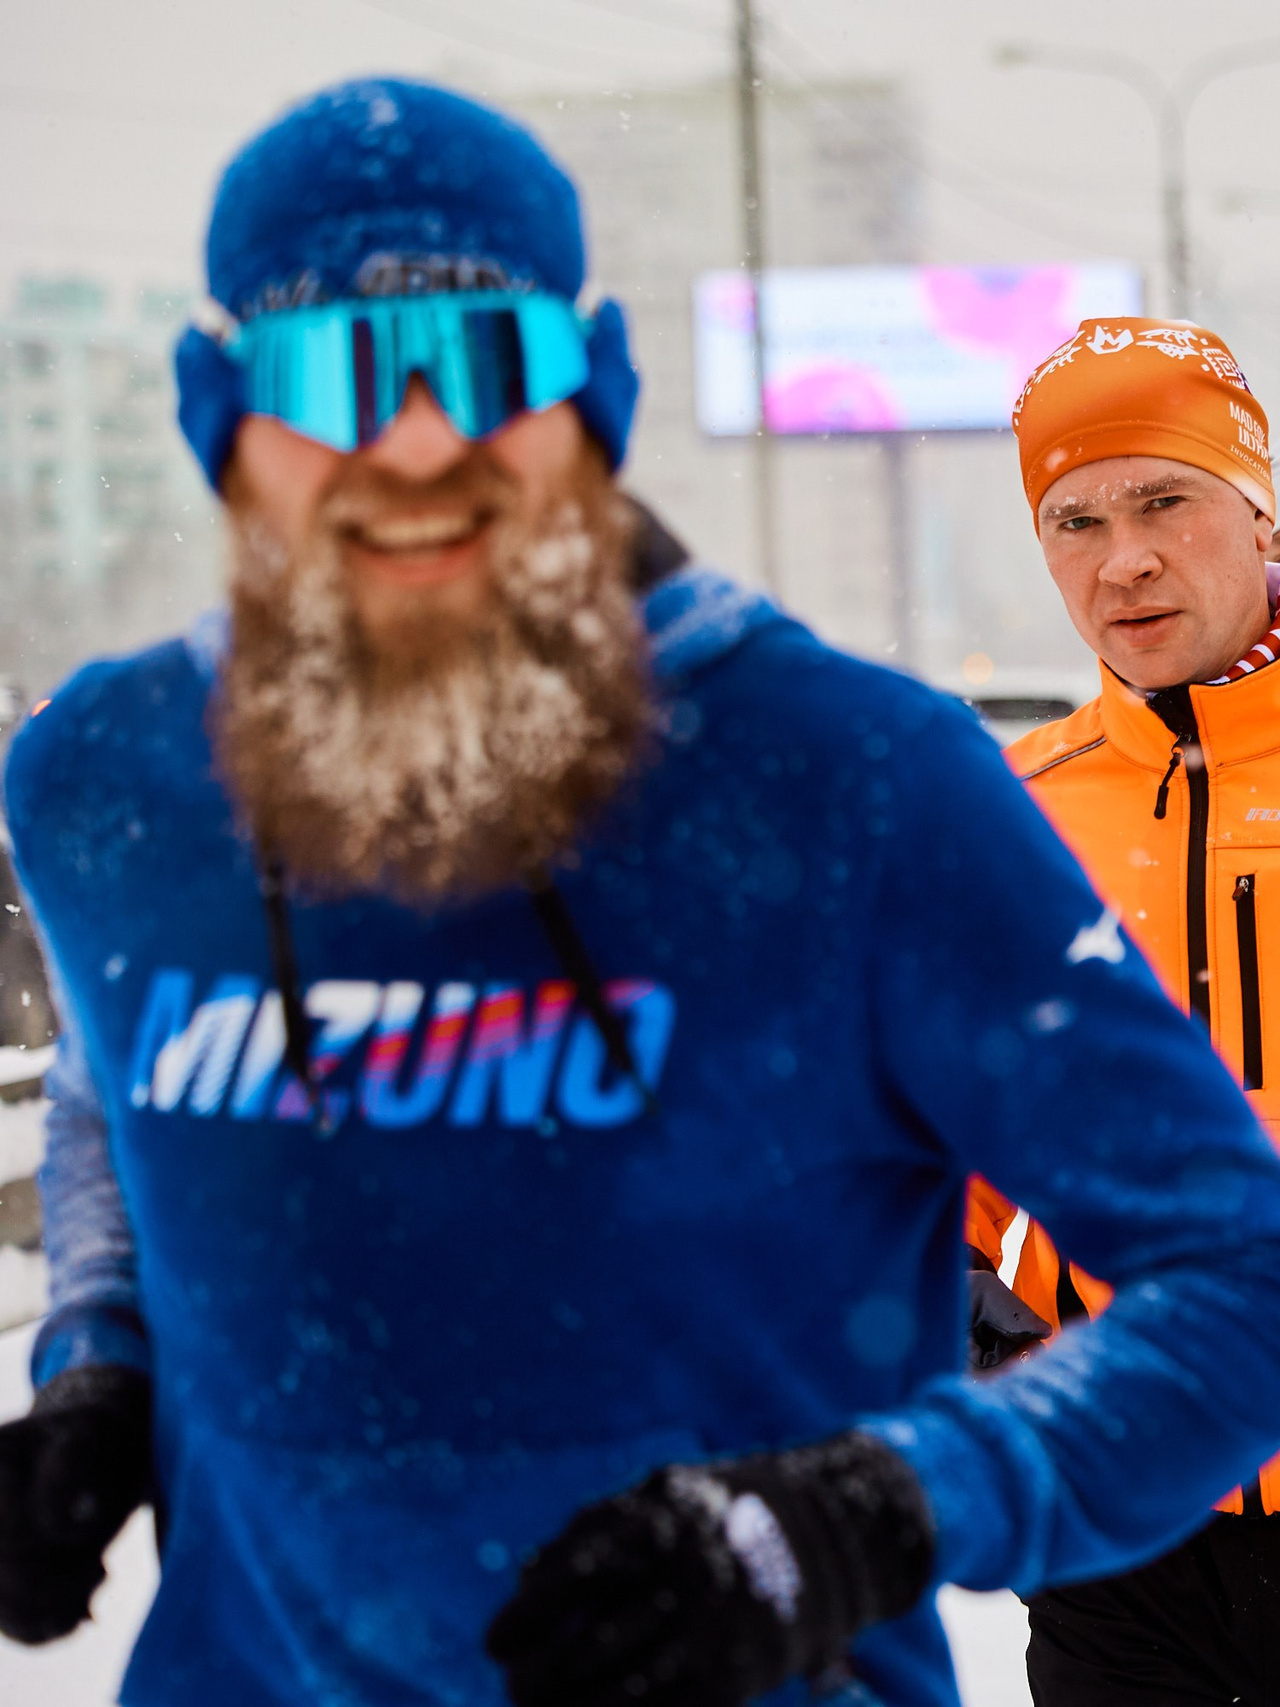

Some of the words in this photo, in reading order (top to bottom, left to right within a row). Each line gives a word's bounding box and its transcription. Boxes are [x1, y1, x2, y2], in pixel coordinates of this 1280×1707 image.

[1229, 401, 1253, 432] MAD
[1230, 444, 1271, 481] INVOCATION
[1238, 425, 1270, 463] ULTRA
[130, 969, 676, 1129] MIZUNO
